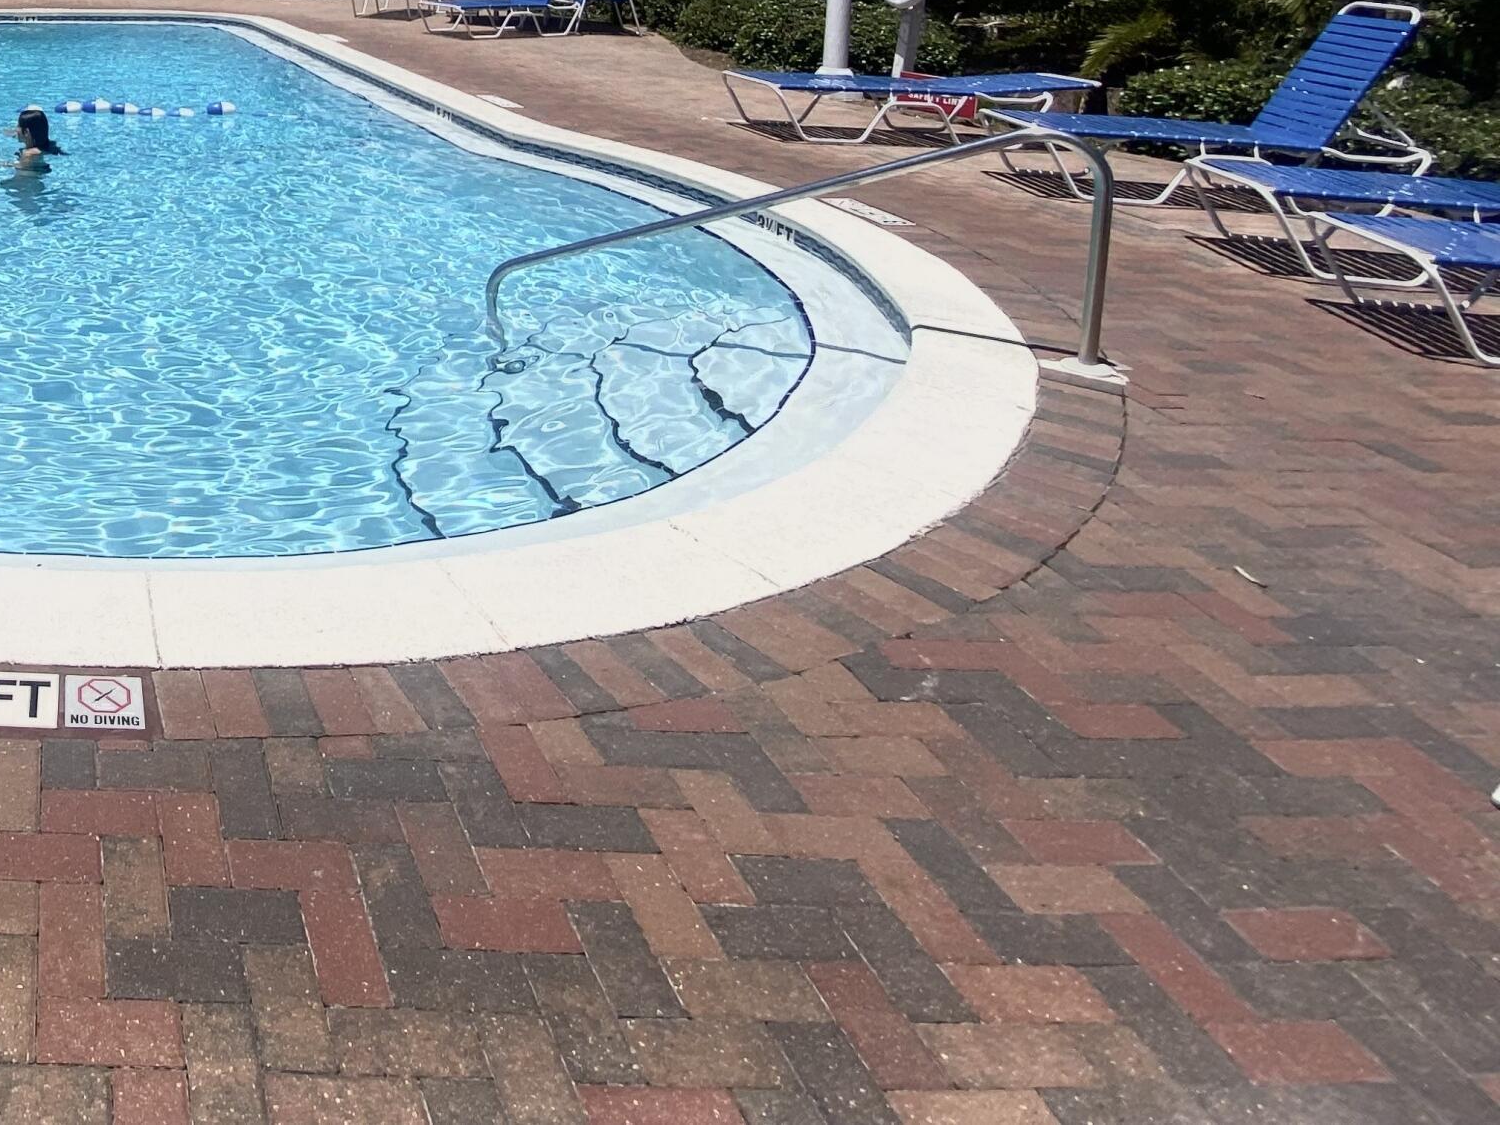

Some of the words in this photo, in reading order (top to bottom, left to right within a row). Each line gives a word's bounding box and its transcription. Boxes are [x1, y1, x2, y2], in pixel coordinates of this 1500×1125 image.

[776, 222, 794, 242] FT
[70, 714, 88, 725] NO
[94, 714, 140, 726] DIVING
